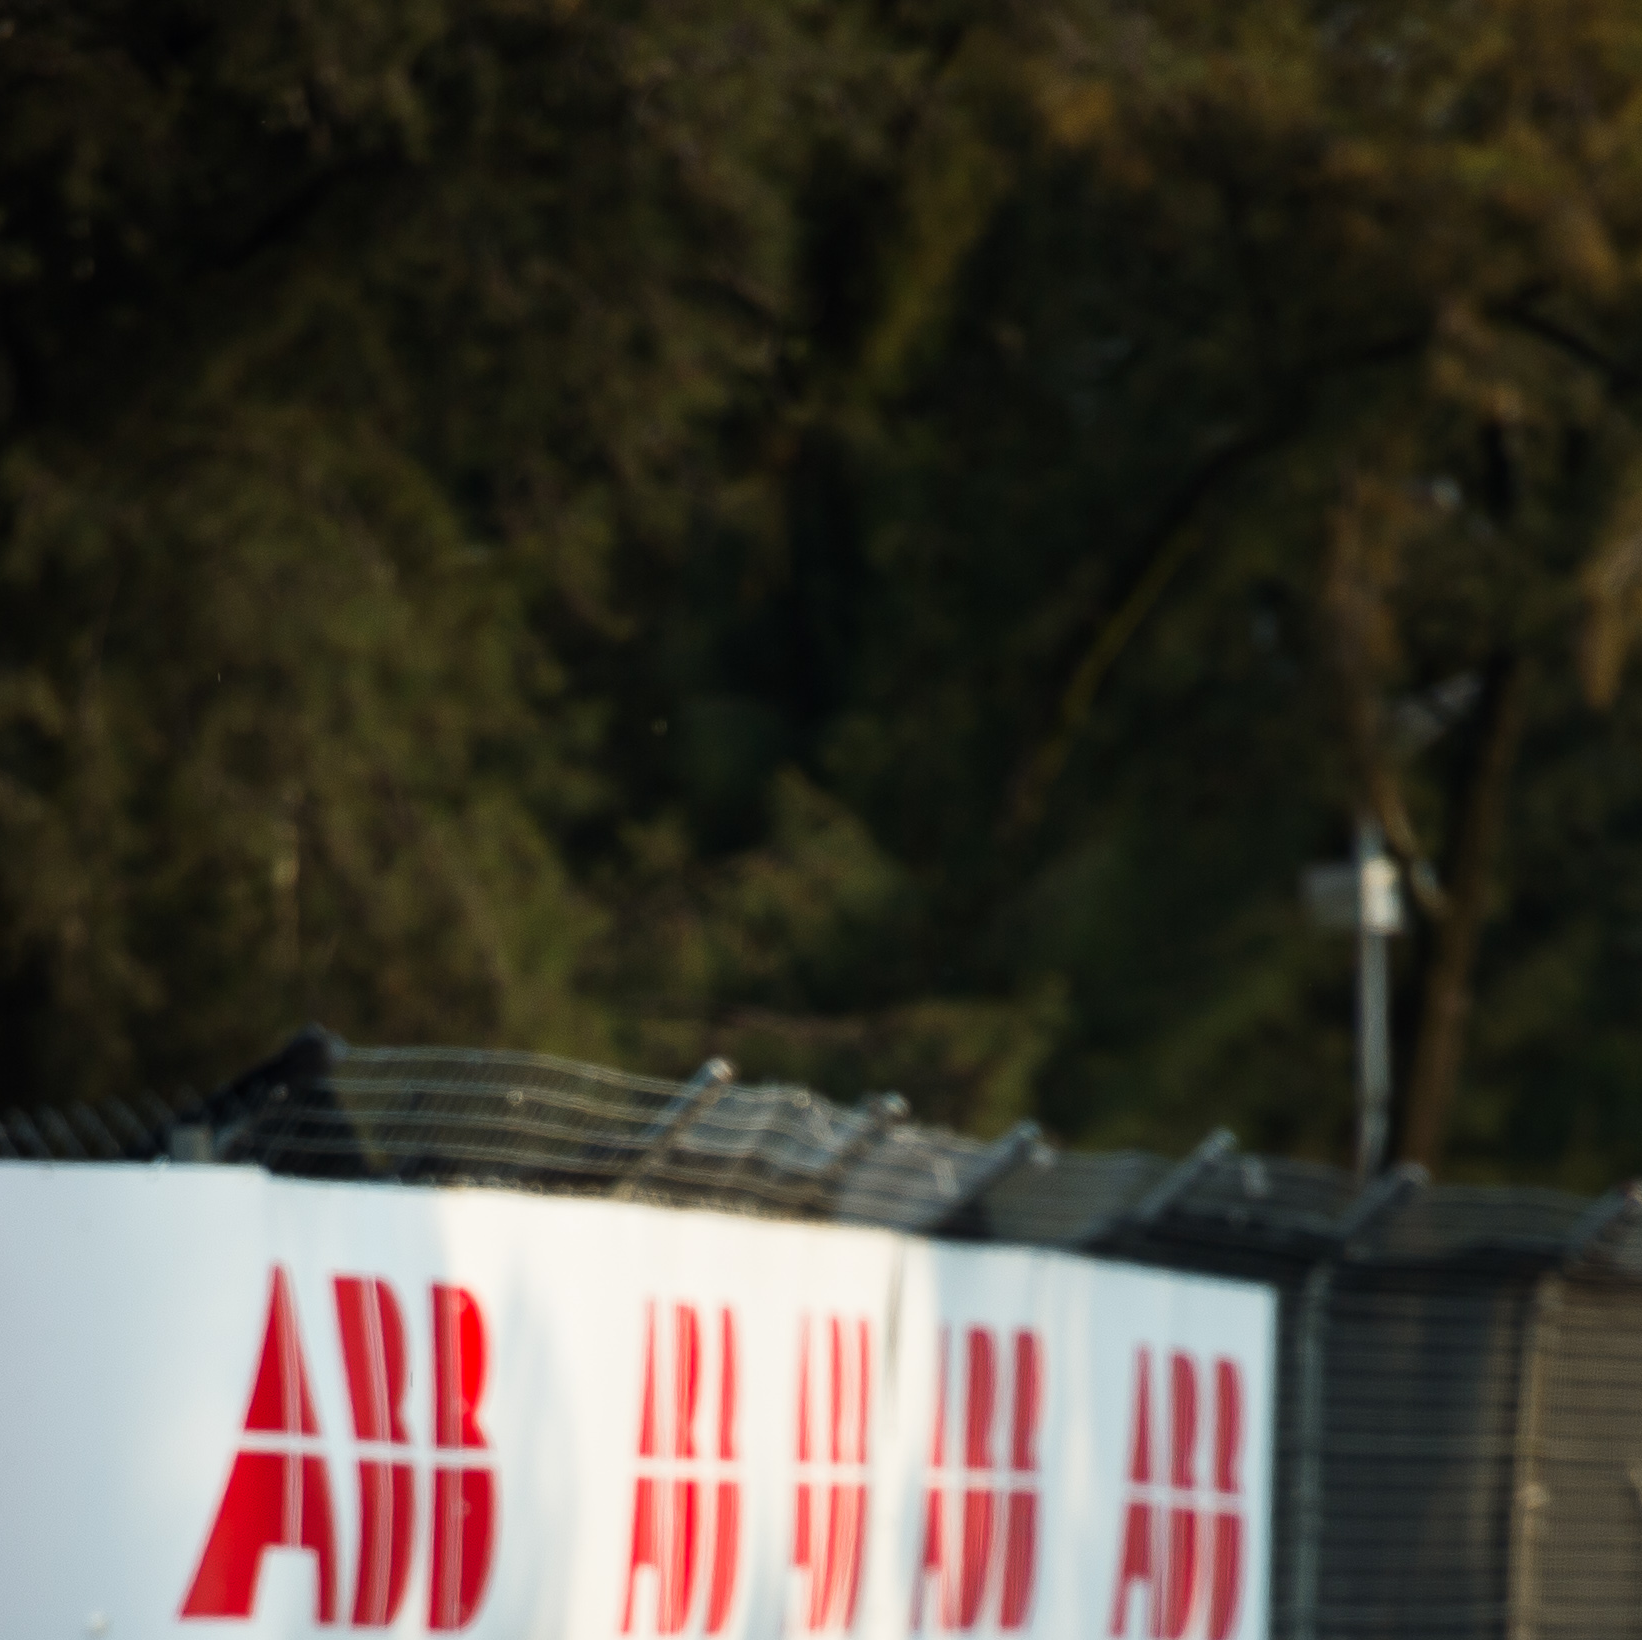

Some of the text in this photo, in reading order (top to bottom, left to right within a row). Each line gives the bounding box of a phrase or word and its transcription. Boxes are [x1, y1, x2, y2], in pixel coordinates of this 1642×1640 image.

[178, 1263, 500, 1633] ABB
[619, 1300, 744, 1637] ABB
[791, 1314, 873, 1633] ABB
[913, 1326, 1044, 1632] ABB
